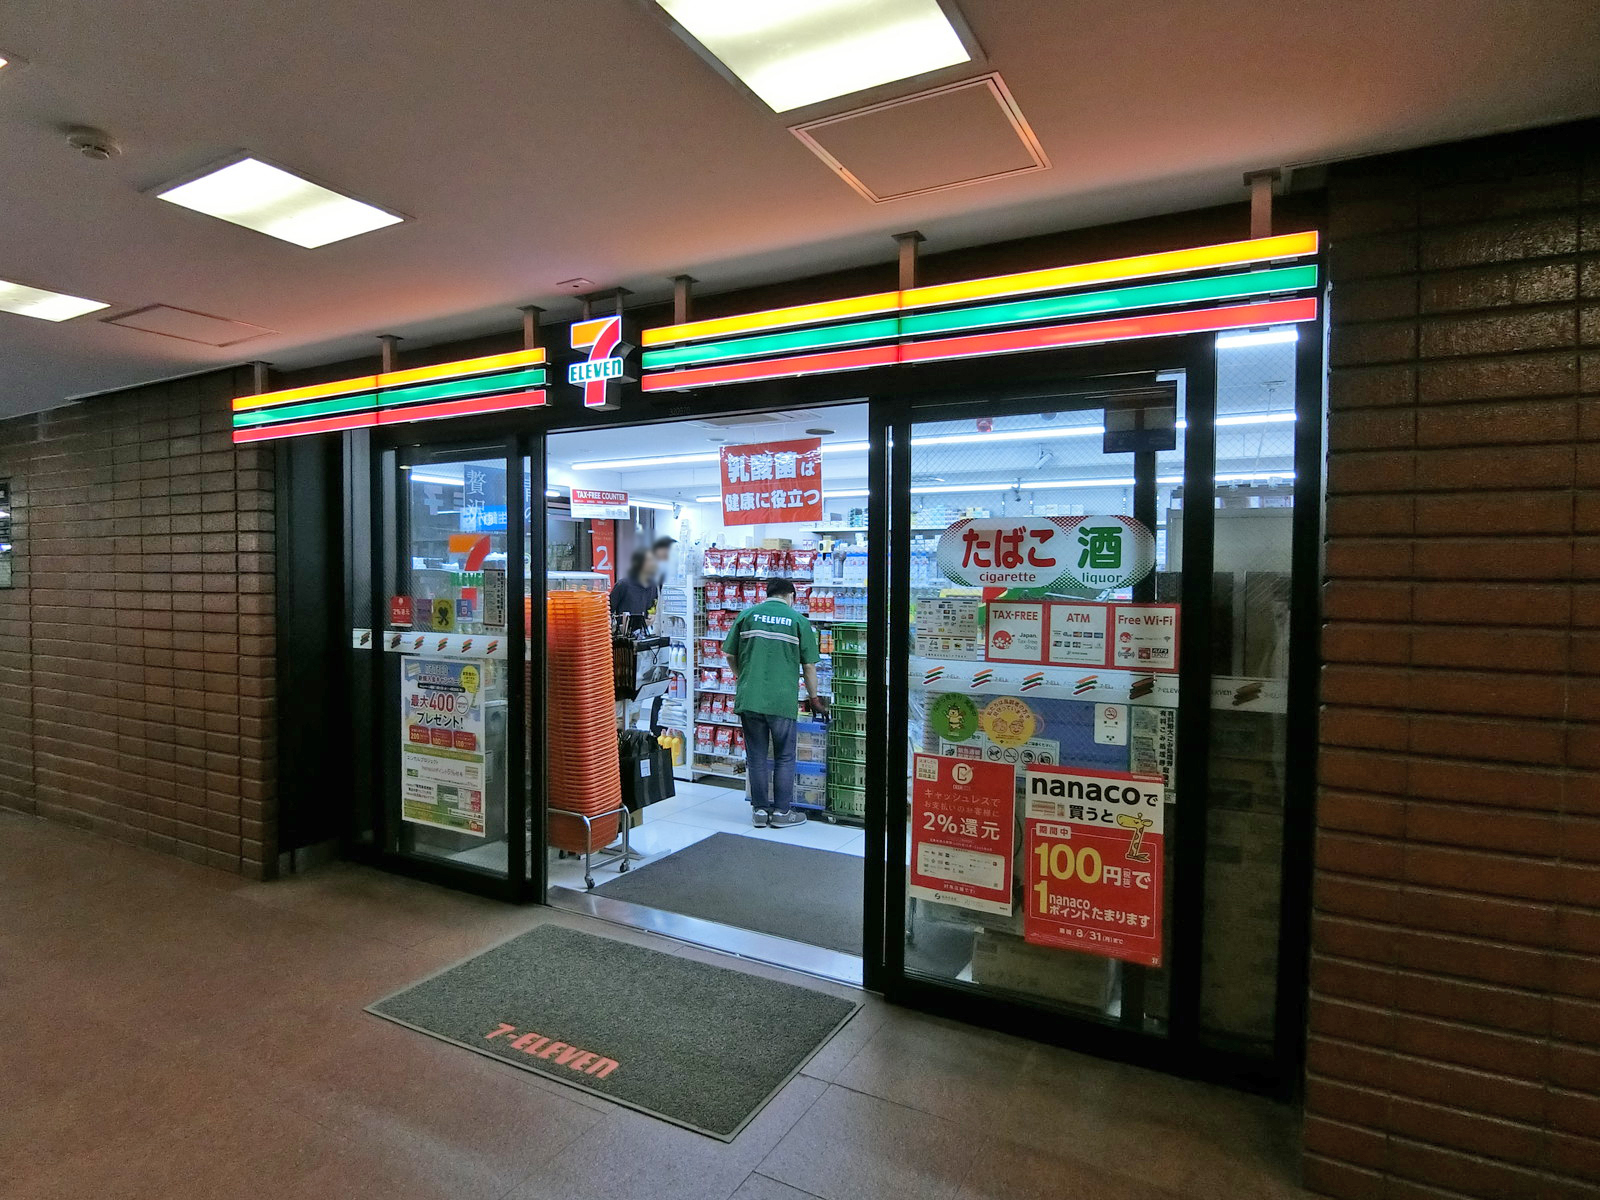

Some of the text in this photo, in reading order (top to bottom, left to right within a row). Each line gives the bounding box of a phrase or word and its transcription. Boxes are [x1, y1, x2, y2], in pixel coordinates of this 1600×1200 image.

[727, 451, 816, 484] 乳酸菌は
[576, 490, 626, 501] TAX-FREE COUNTER
[725, 488, 821, 512] 健康に役立つ
[962, 525, 1123, 569] たばこ 酒
[979, 571, 1123, 585] cigarette liquor
[992, 610, 1039, 621] TAX-FREE
[1066, 613, 1091, 623] ATM
[1118, 615, 1173, 627] Free Wi-Fi
[924, 788, 1001, 808] キャッシュレスで
[1069, 804, 1114, 823] 買うと
[923, 811, 1001, 841] 2%還元
[1039, 825, 1070, 837] 期間中
